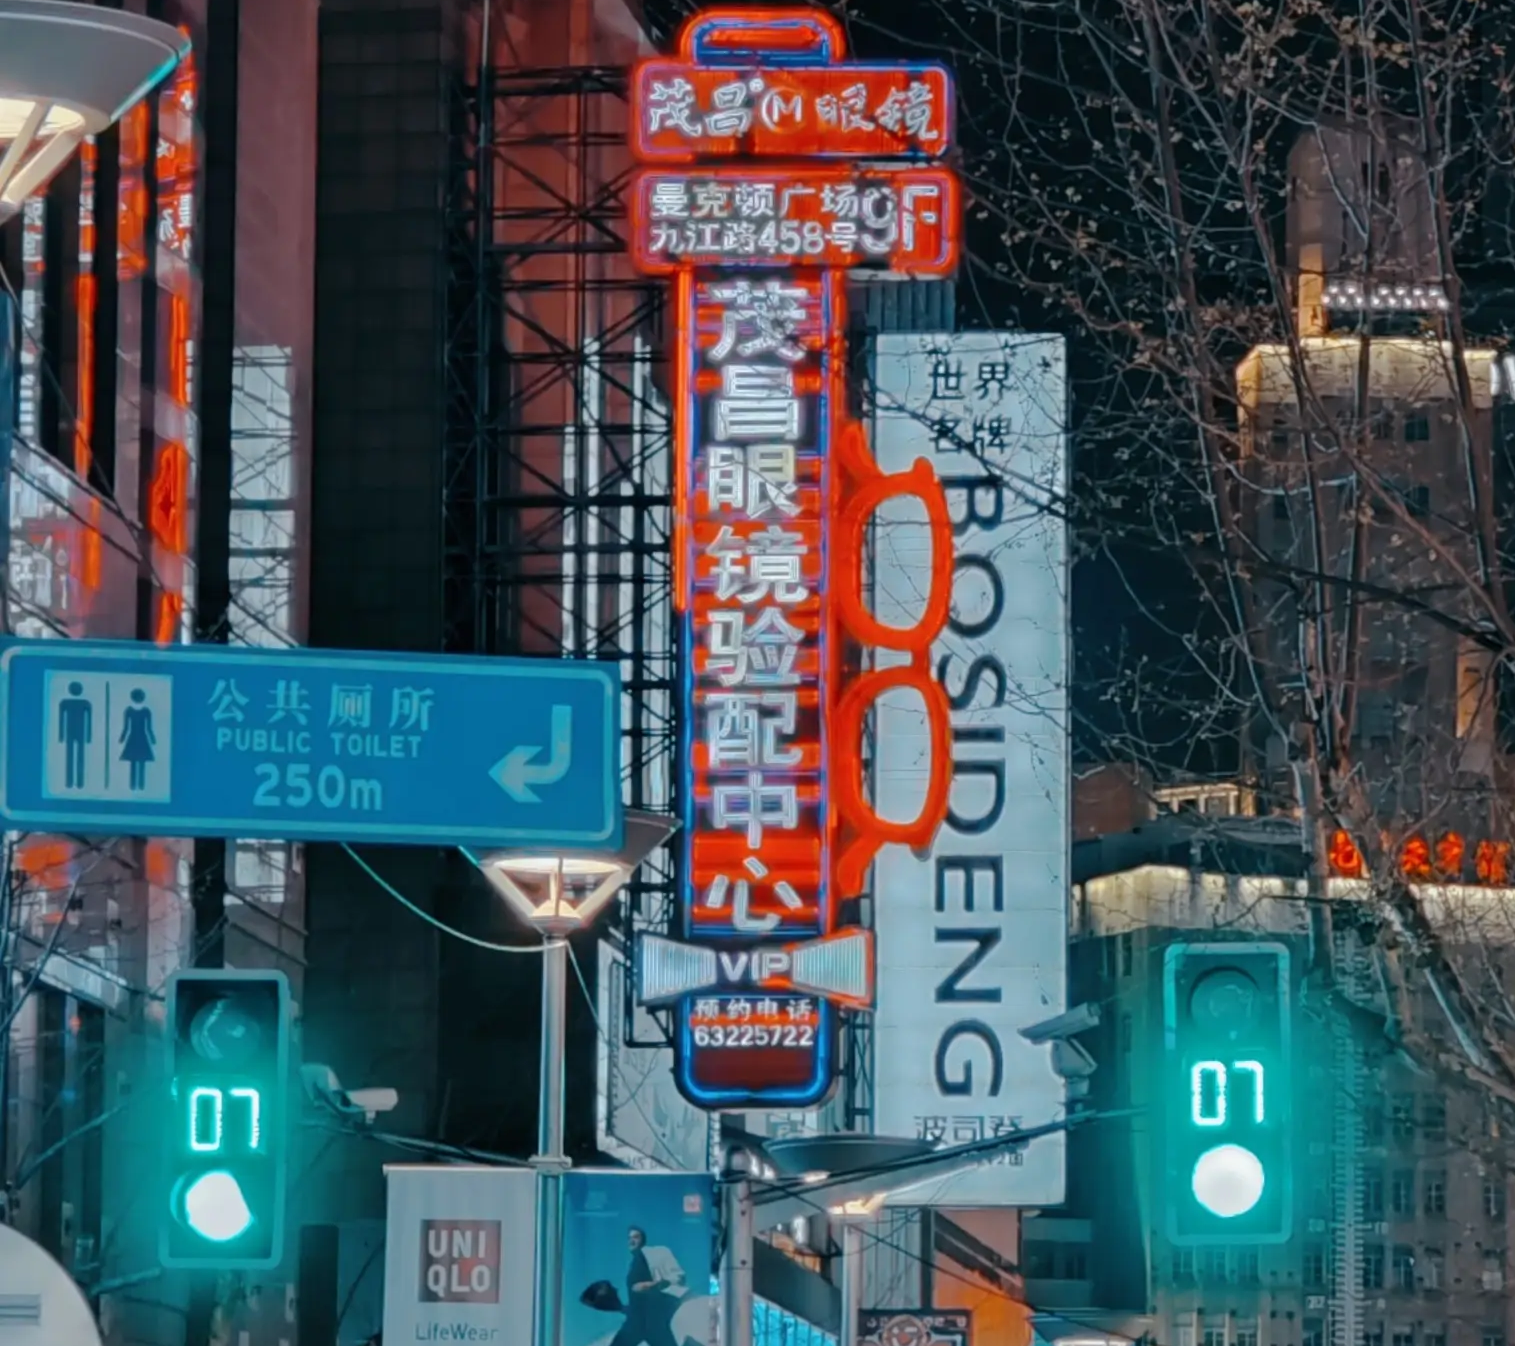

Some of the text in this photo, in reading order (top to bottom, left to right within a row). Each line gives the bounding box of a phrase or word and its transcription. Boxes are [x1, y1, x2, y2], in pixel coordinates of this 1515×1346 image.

[649, 80, 750, 139] 茂昌
[816, 84, 940, 140] 眼镜
[650, 182, 858, 217] 曼克顿广场
[650, 220, 858, 255] 九江路458号
[929, 361, 1010, 400] 世界
[707, 281, 809, 931] 茂昌眼镜验配中心
[207, 678, 435, 732] 公共厕所
[217, 728, 422, 758] PUBLIC TOILET
[253, 763, 383, 810] 250m
[933, 475, 1005, 1098] BOSIDENG
[717, 953, 791, 982] VIP
[695, 998, 812, 1023] 预约电话
[694, 1024, 813, 1047] 63225722
[1192, 1060, 1265, 1126] 07
[191, 1087, 259, 1151] 07
[427, 1229, 487, 1258] UNI
[426, 1264, 491, 1298] QLO
[415, 1321, 498, 1342] LifeWear
